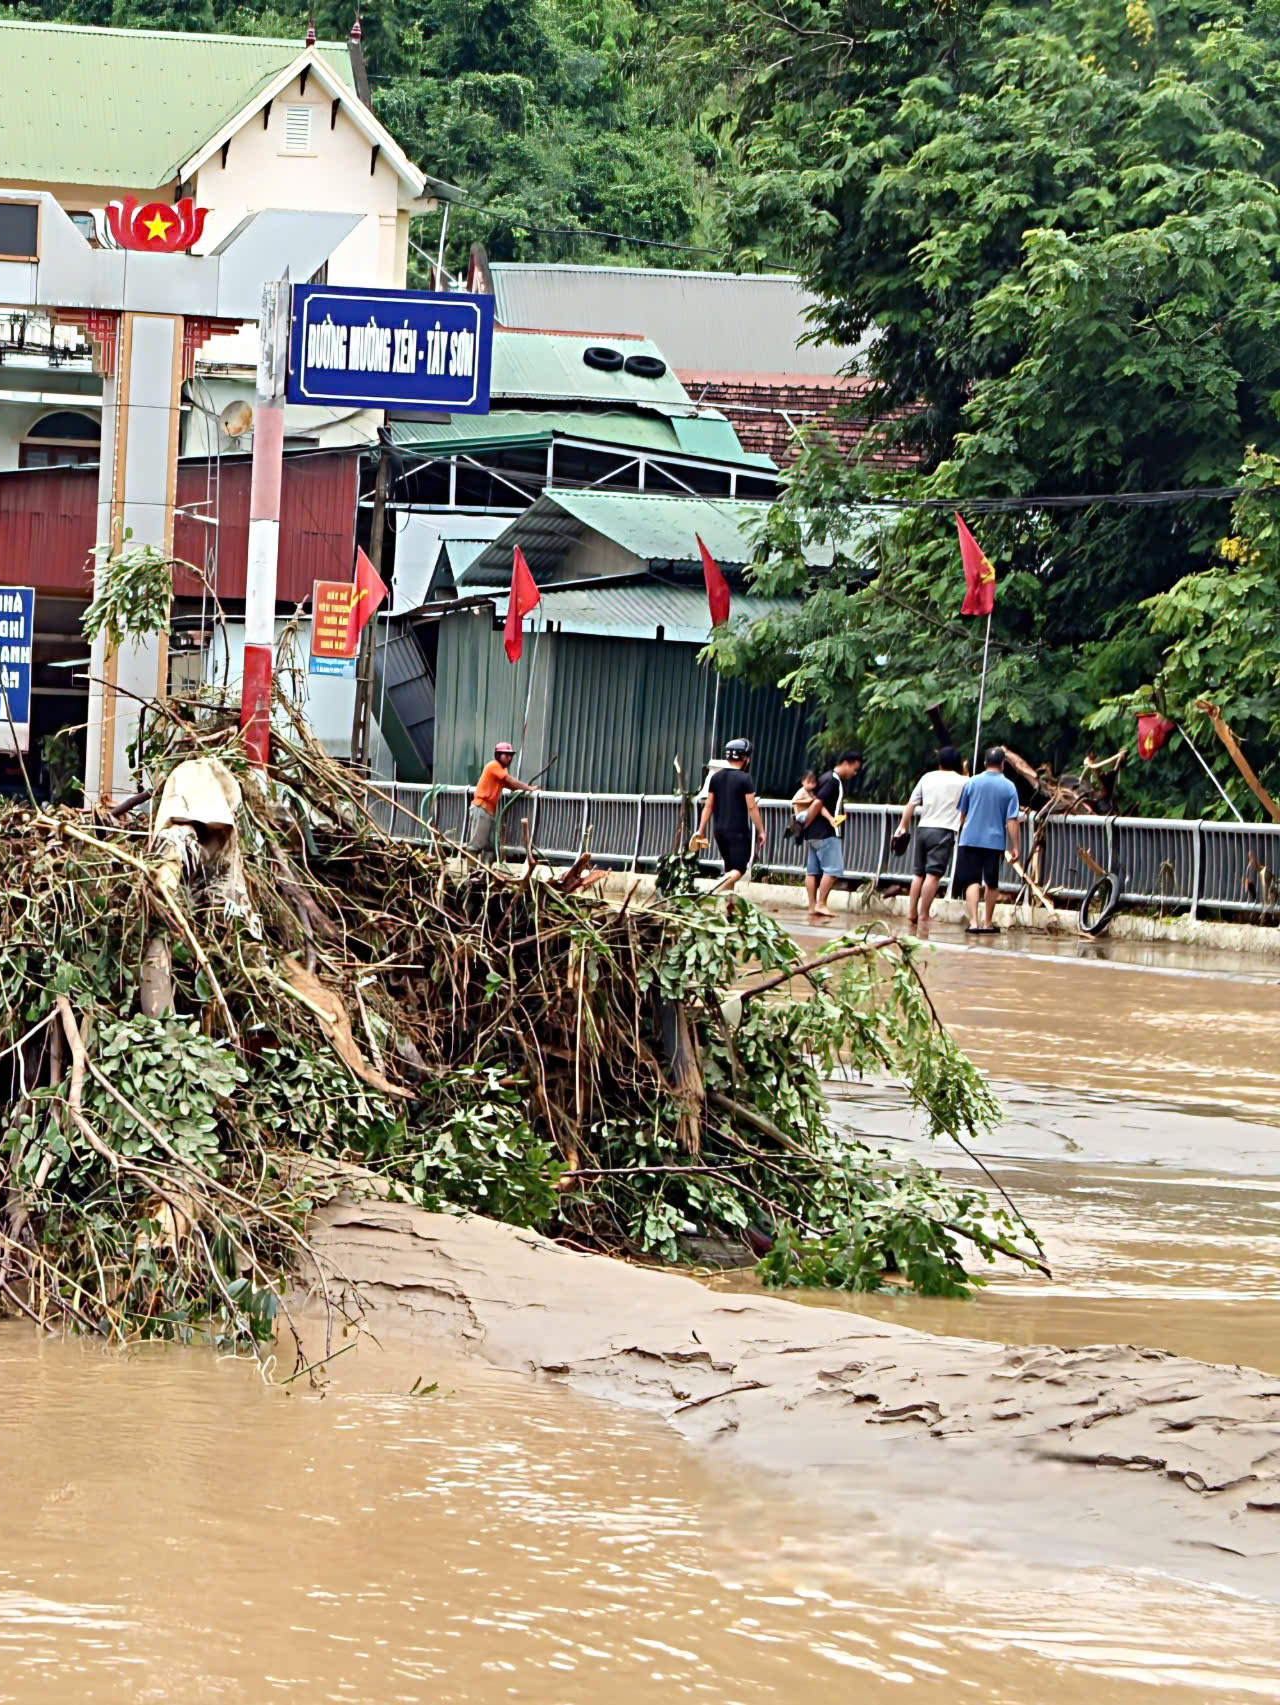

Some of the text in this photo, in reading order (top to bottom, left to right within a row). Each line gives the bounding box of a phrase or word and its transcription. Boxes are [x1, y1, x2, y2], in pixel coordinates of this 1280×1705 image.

[348, 315, 392, 373] MƯỜNG
[392, 319, 418, 374] XÉN
[427, 321, 449, 375] TÂY
[449, 328, 475, 377] SƠN
